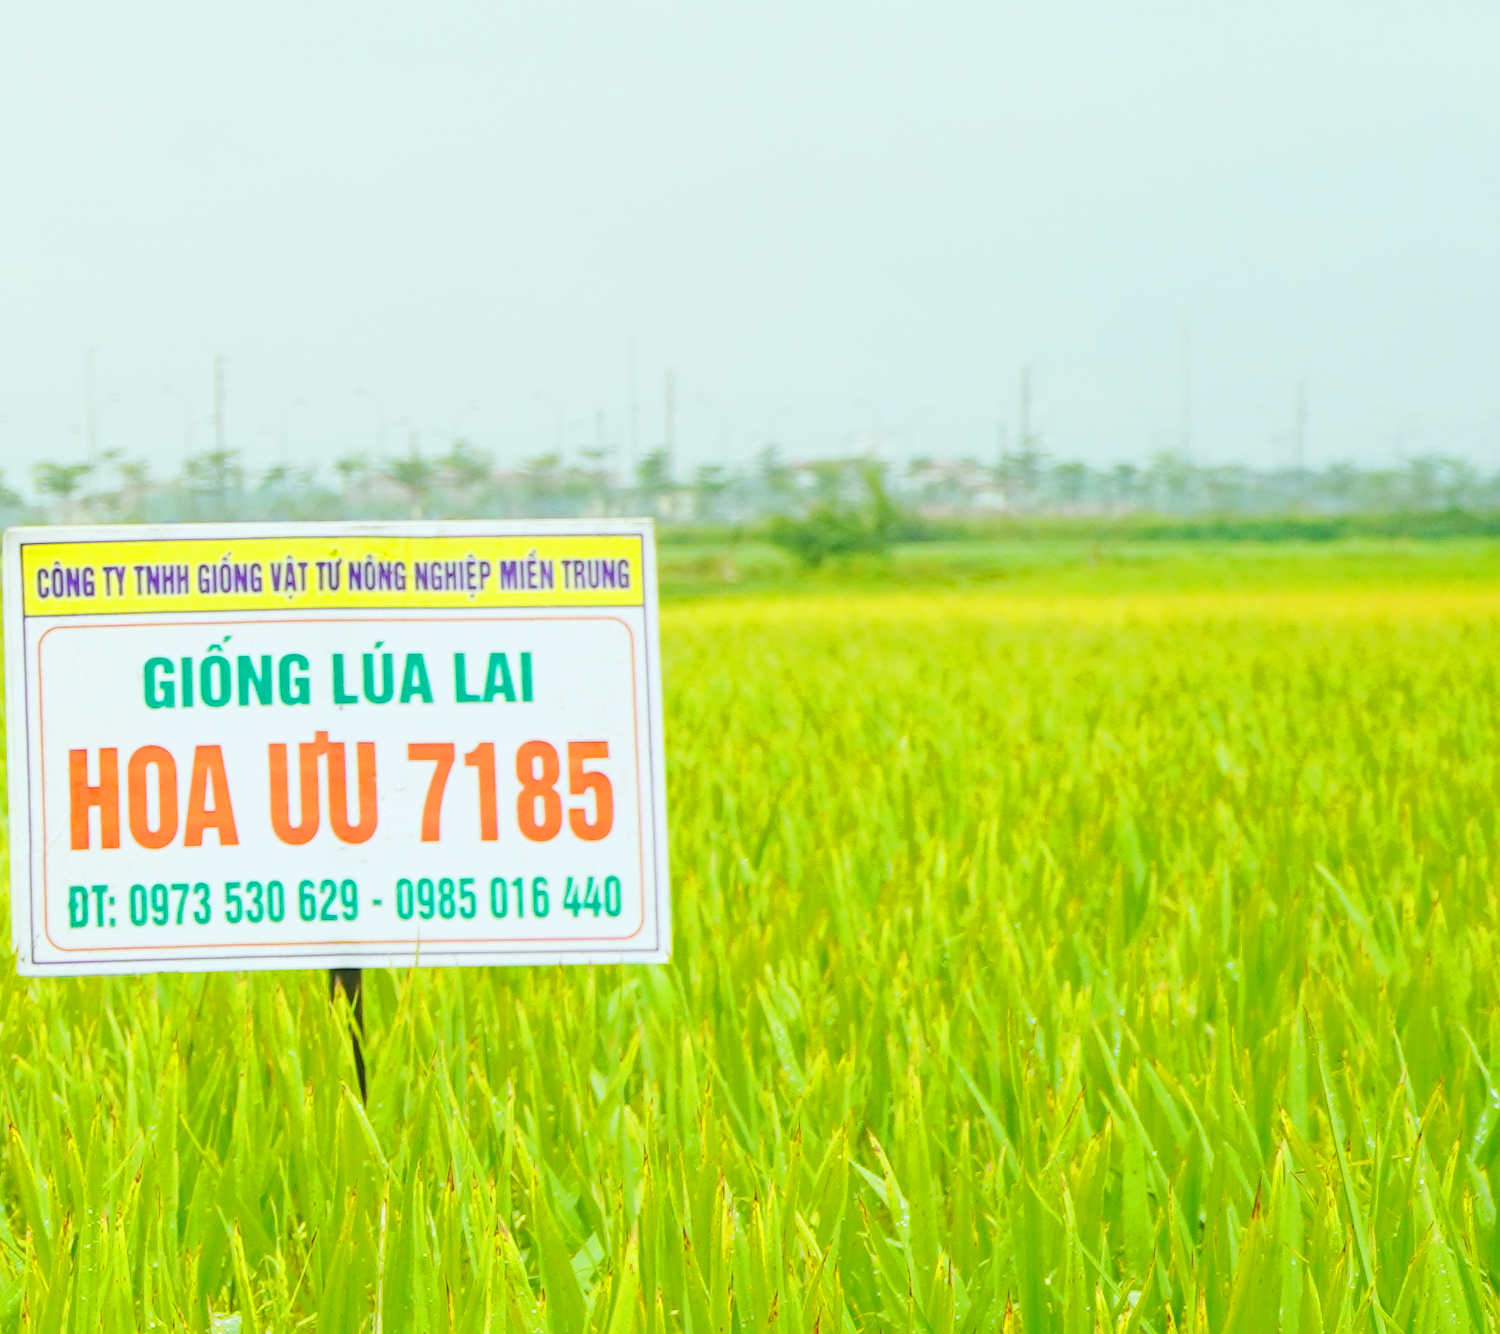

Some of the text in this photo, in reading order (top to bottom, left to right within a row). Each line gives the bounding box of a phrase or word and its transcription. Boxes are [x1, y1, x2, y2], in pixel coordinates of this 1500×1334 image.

[36, 560, 95, 599] CÔNG
[102, 566, 127, 596] TY
[133, 565, 190, 596] TNHH
[198, 551, 263, 594] GIỐNG
[270, 554, 308, 600] VẬT
[348, 554, 406, 592] NÔNG
[414, 553, 491, 598] NGHIỆP
[560, 558, 631, 590] TRUNG
[143, 635, 534, 710] GIỐNG LÚA LAI
[68, 730, 614, 851] HOA ƯU 7185
[67, 884, 116, 929] ĐT:
[129, 882, 212, 927] 0973
[224, 879, 286, 924] 530
[298, 878, 359, 922] 629
[395, 877, 477, 921] 0985
[489, 876, 550, 919] 016
[562, 874, 622, 918] 440
